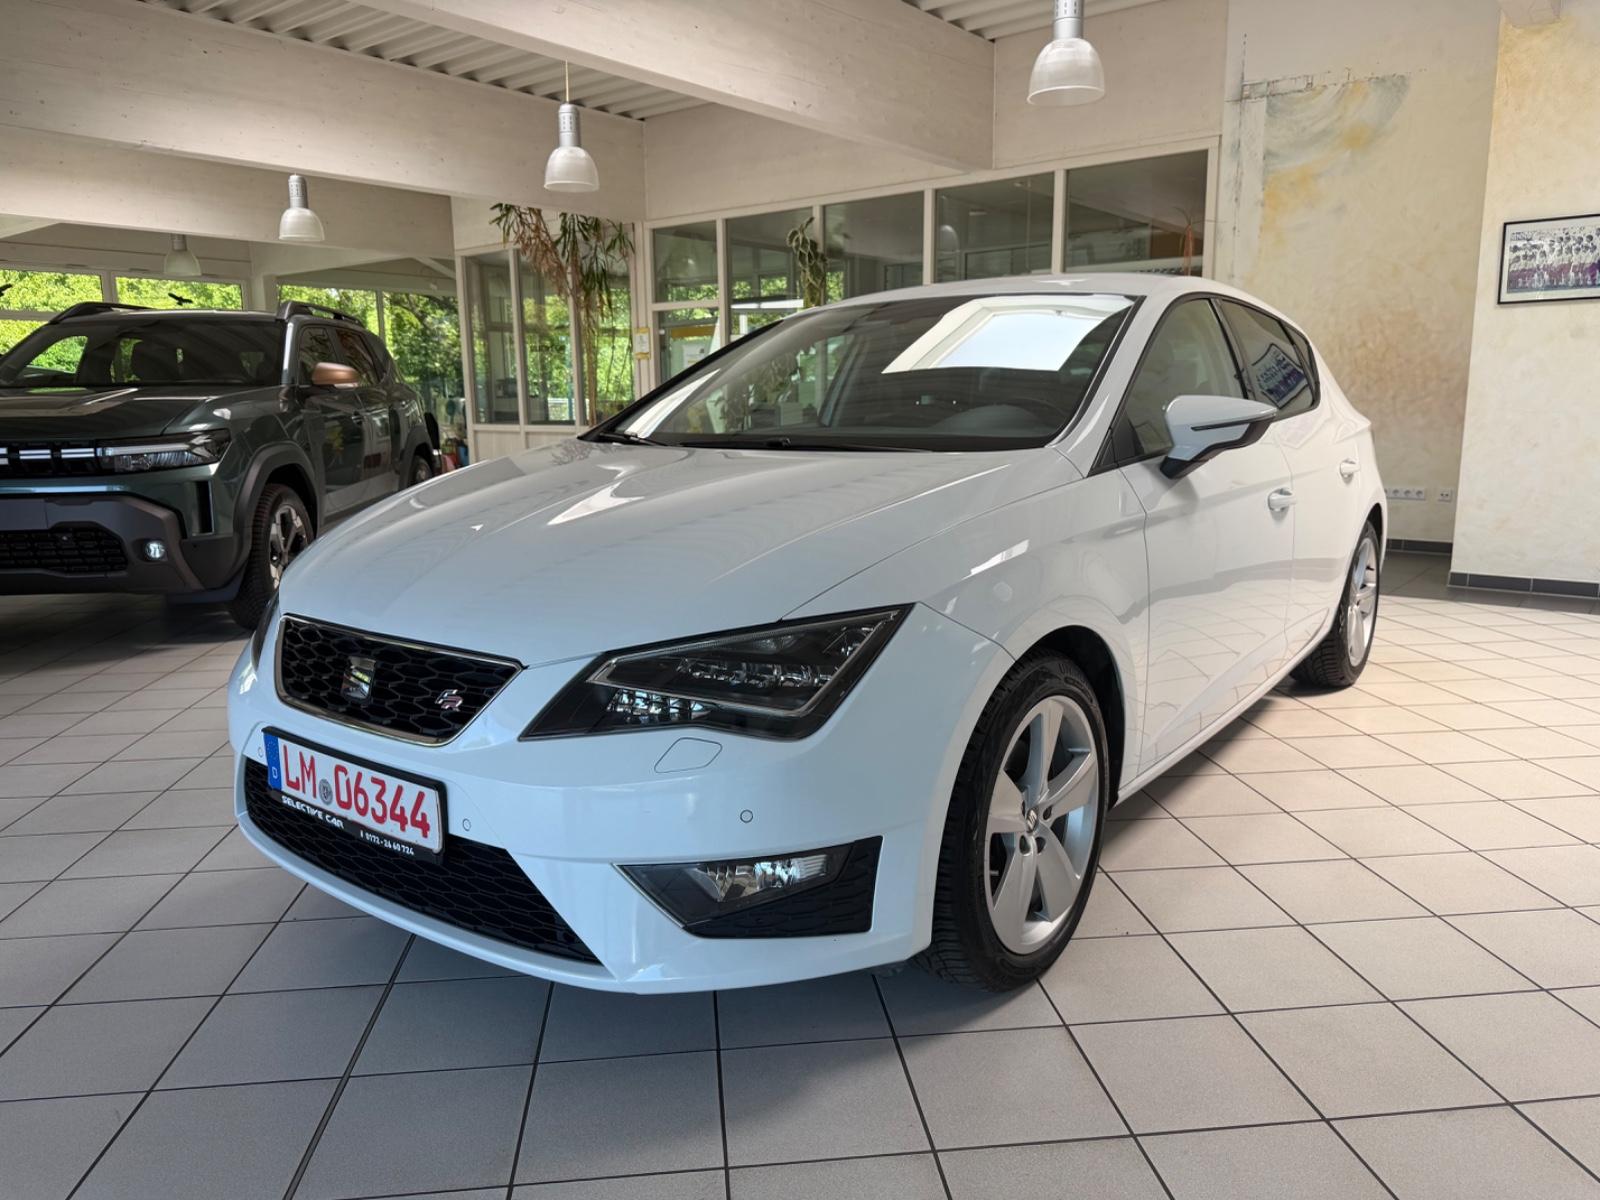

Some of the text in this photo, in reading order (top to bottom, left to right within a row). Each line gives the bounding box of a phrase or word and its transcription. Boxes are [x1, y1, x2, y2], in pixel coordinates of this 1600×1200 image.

[271, 766, 278, 780] D
[283, 744, 431, 839] LM 06344
[281, 795, 345, 830] SELECTIVE CAR
